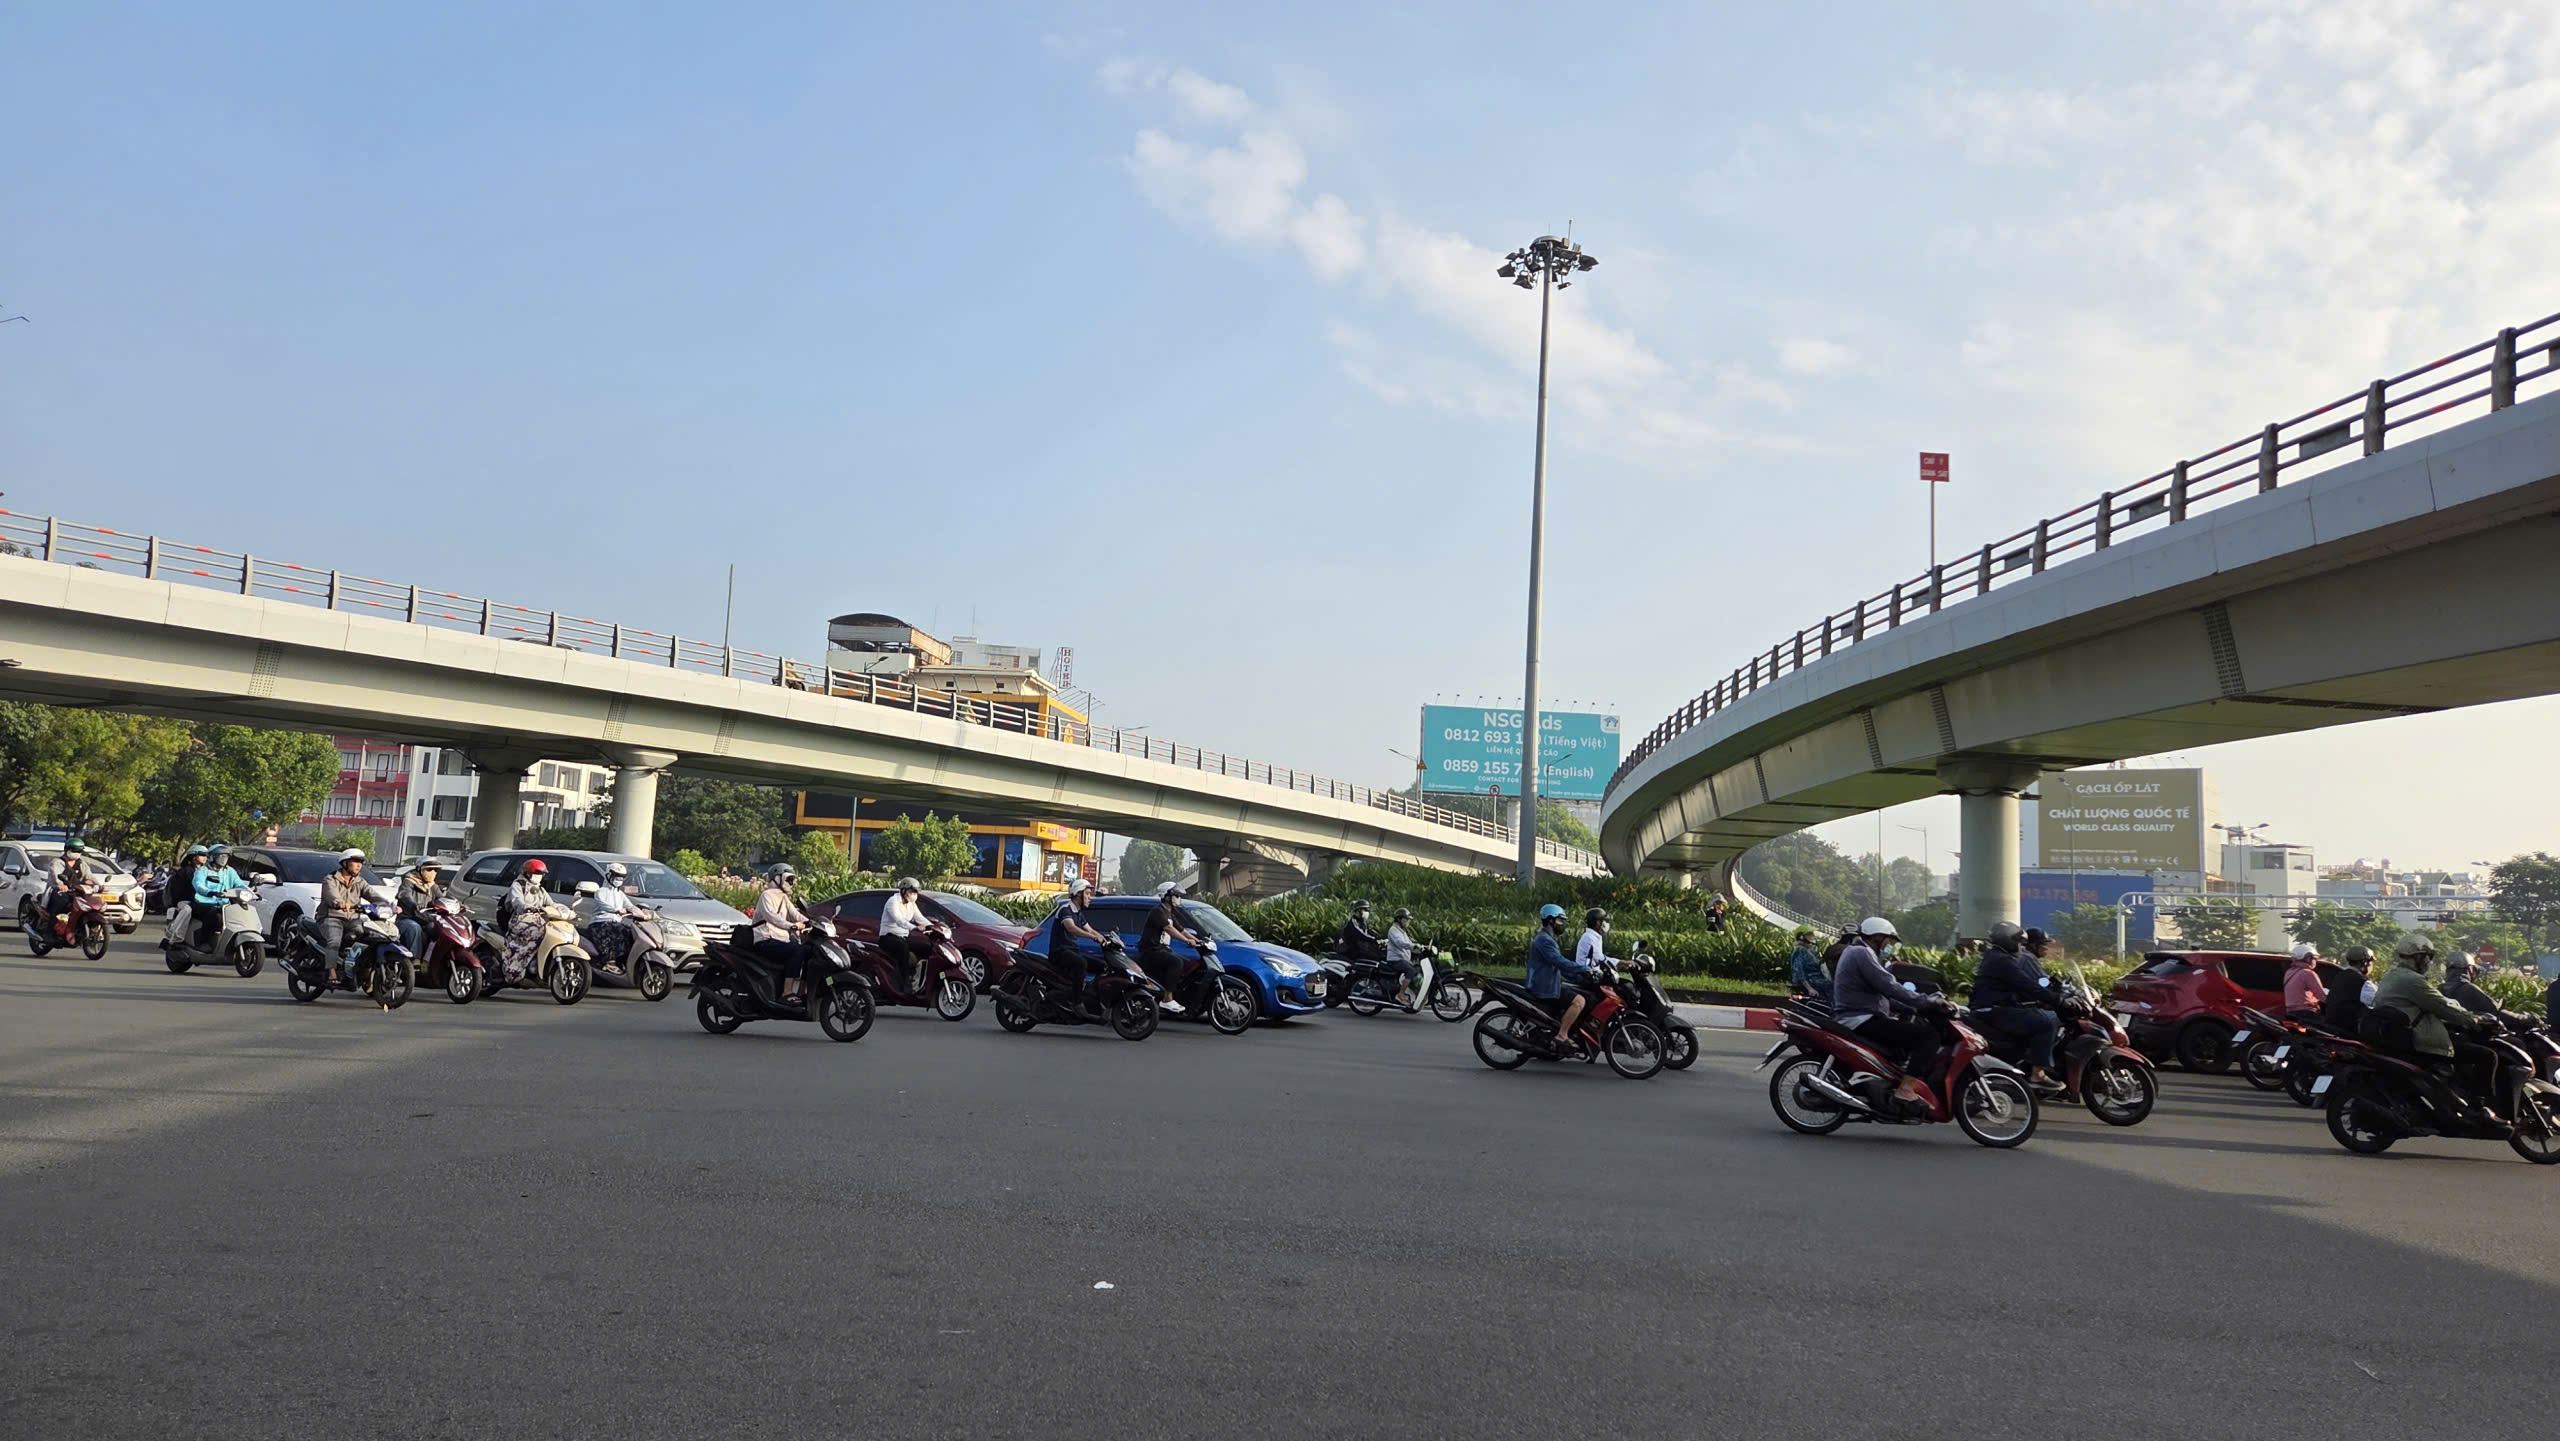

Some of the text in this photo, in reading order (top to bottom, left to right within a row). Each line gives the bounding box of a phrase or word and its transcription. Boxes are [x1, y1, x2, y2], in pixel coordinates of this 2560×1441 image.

[1483, 712, 1523, 729] NSG
[1444, 728, 1480, 742] 0812
[1484, 730, 1511, 744] 693
[1580, 737, 1607, 750] Việt)
[1443, 759, 1479, 773] 0859
[1483, 761, 1510, 775] 155
[1543, 764, 1594, 779] (English)
[1478, 776, 1506, 784] CONTACT
[2076, 784, 2112, 795] GẠCH
[2084, 807, 2130, 821] LƯỢNG
[2133, 805, 2173, 819] QUỐC
[2175, 806, 2190, 819] TẾ
[2063, 823, 2176, 832] WORLD CLASS QUALITY
